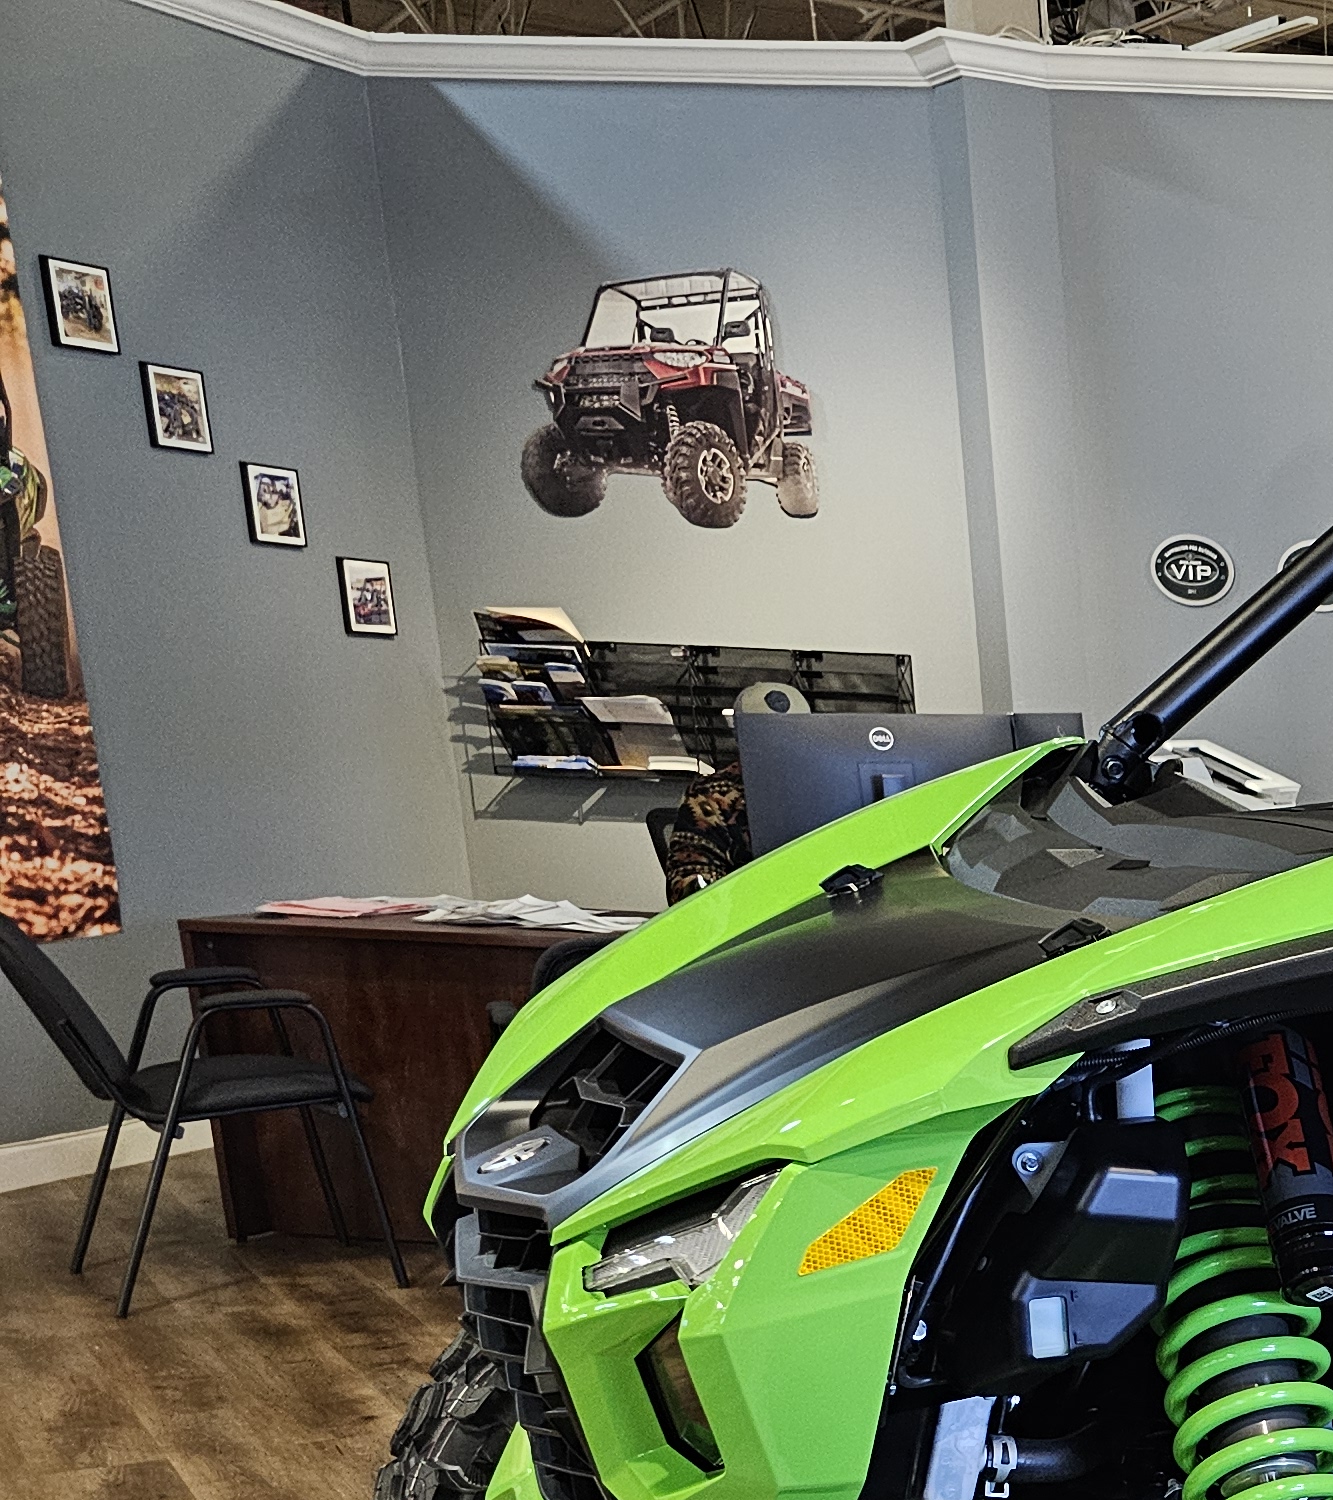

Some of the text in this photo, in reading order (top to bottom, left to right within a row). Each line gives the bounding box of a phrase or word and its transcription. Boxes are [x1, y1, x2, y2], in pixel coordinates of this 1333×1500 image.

[1170, 563, 1211, 581] VIP
[1239, 1031, 1312, 1190] FOX
[1273, 1205, 1317, 1232] VALVE
